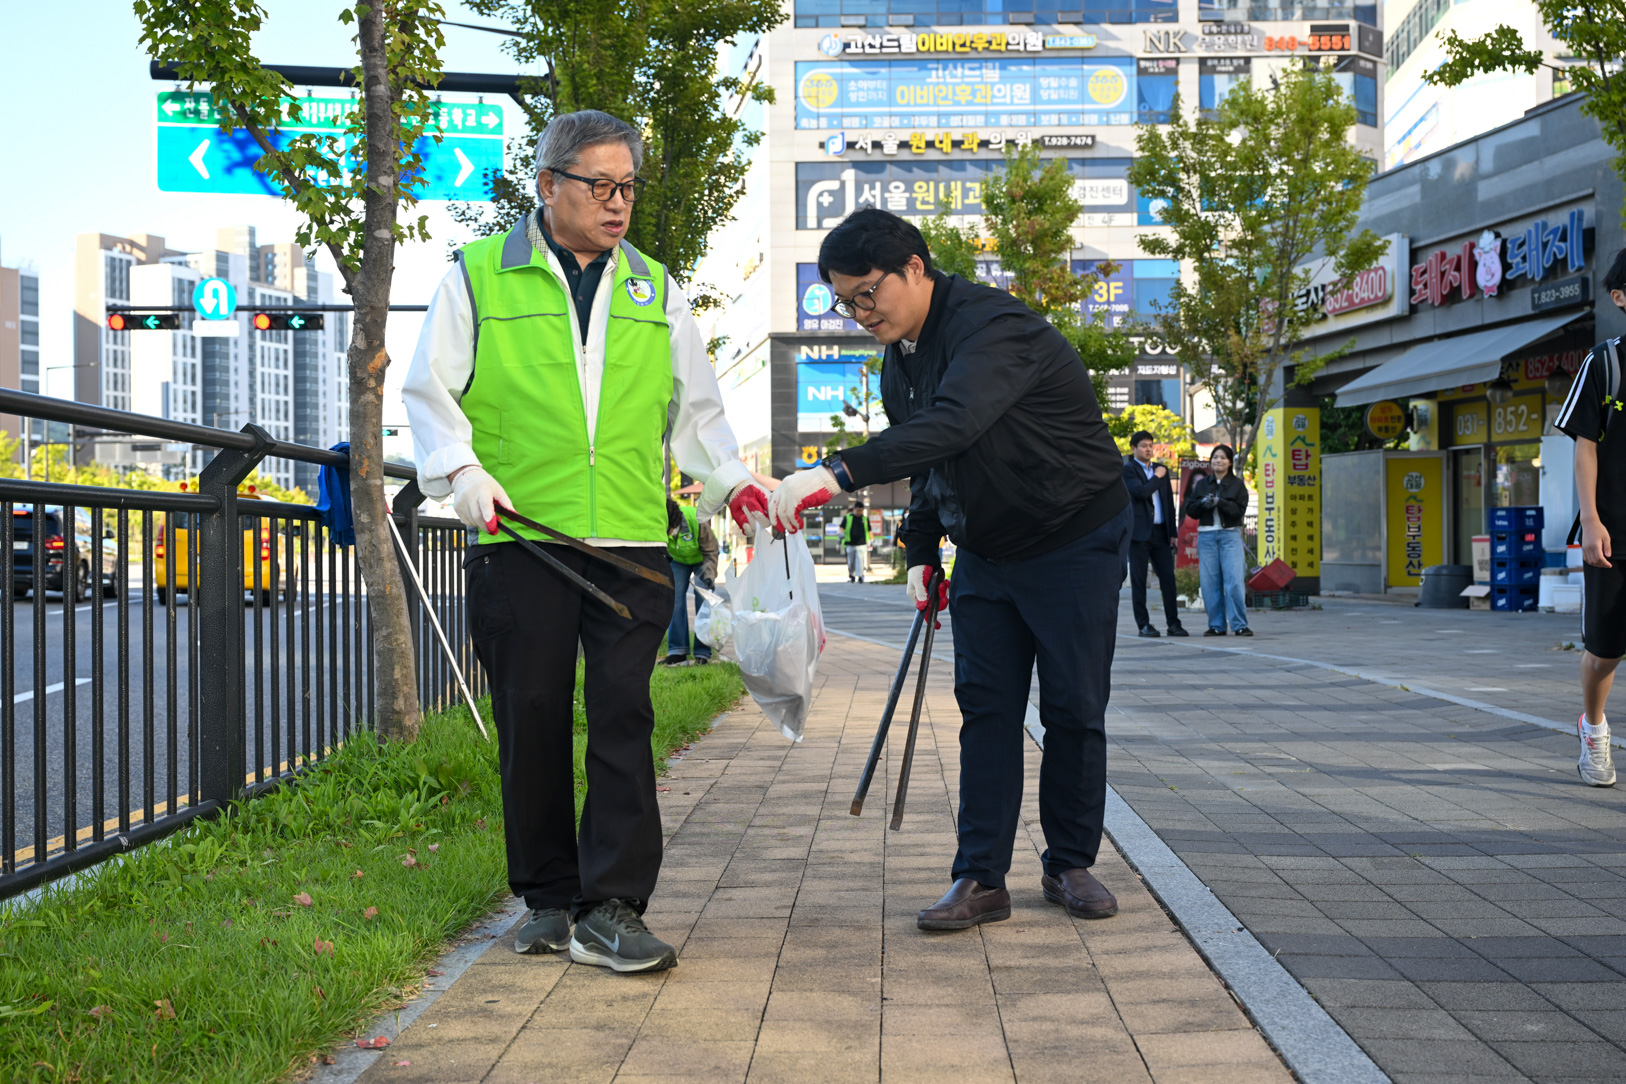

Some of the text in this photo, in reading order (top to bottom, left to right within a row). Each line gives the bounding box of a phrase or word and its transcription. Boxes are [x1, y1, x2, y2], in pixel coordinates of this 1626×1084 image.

[1143, 29, 1187, 53] NK
[1264, 35, 1350, 51] 848-5551
[926, 63, 1000, 82] 고산드림
[896, 83, 1031, 105] 이비인후과의원
[1043, 135, 1092, 146] T.928-7474
[1410, 208, 1586, 307] 돼지 돼지
[1094, 281, 1123, 302] 3F
[1533, 286, 1581, 305] T.823-3955
[800, 345, 839, 360] NH
[807, 386, 844, 401] NH
[1456, 413, 1485, 436] 031-
[1494, 404, 1539, 434] 852-
[1181, 458, 1211, 470] zigban
[1291, 448, 1312, 471] 탑
[1288, 475, 1316, 486] 부동산
